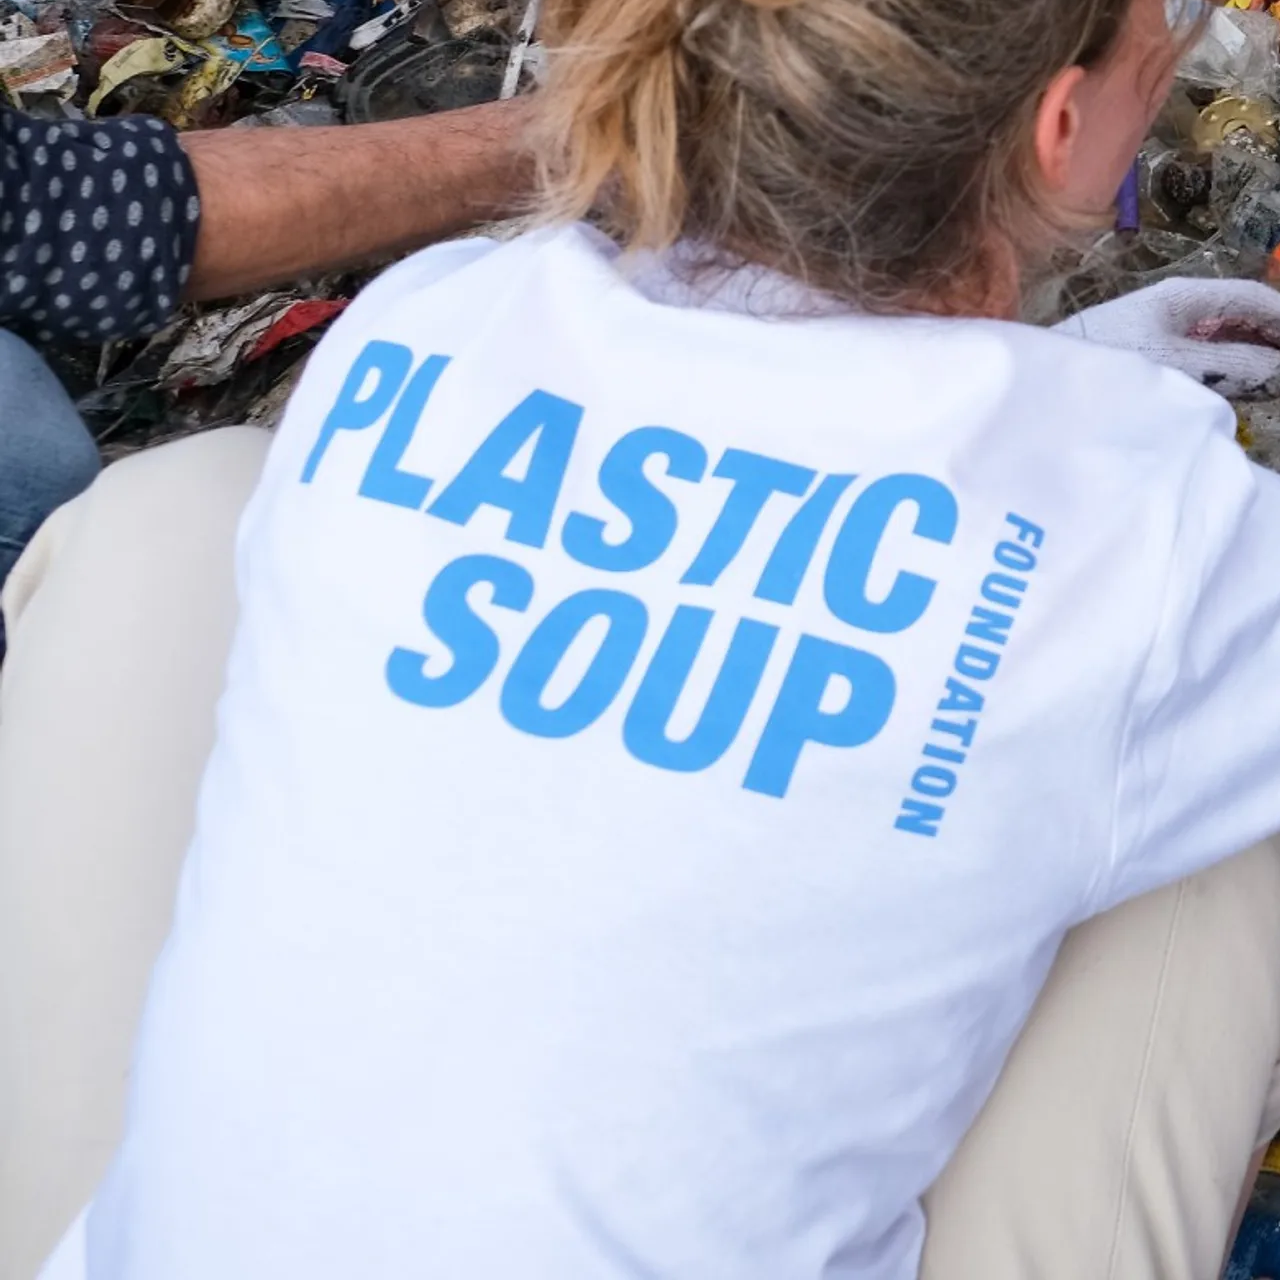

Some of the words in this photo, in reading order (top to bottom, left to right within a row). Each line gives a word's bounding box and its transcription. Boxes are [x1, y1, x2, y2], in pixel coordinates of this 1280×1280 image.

[301, 338, 959, 635] PLASTIC
[385, 553, 896, 799] SOUP
[893, 511, 1046, 838] FOUNDATION
